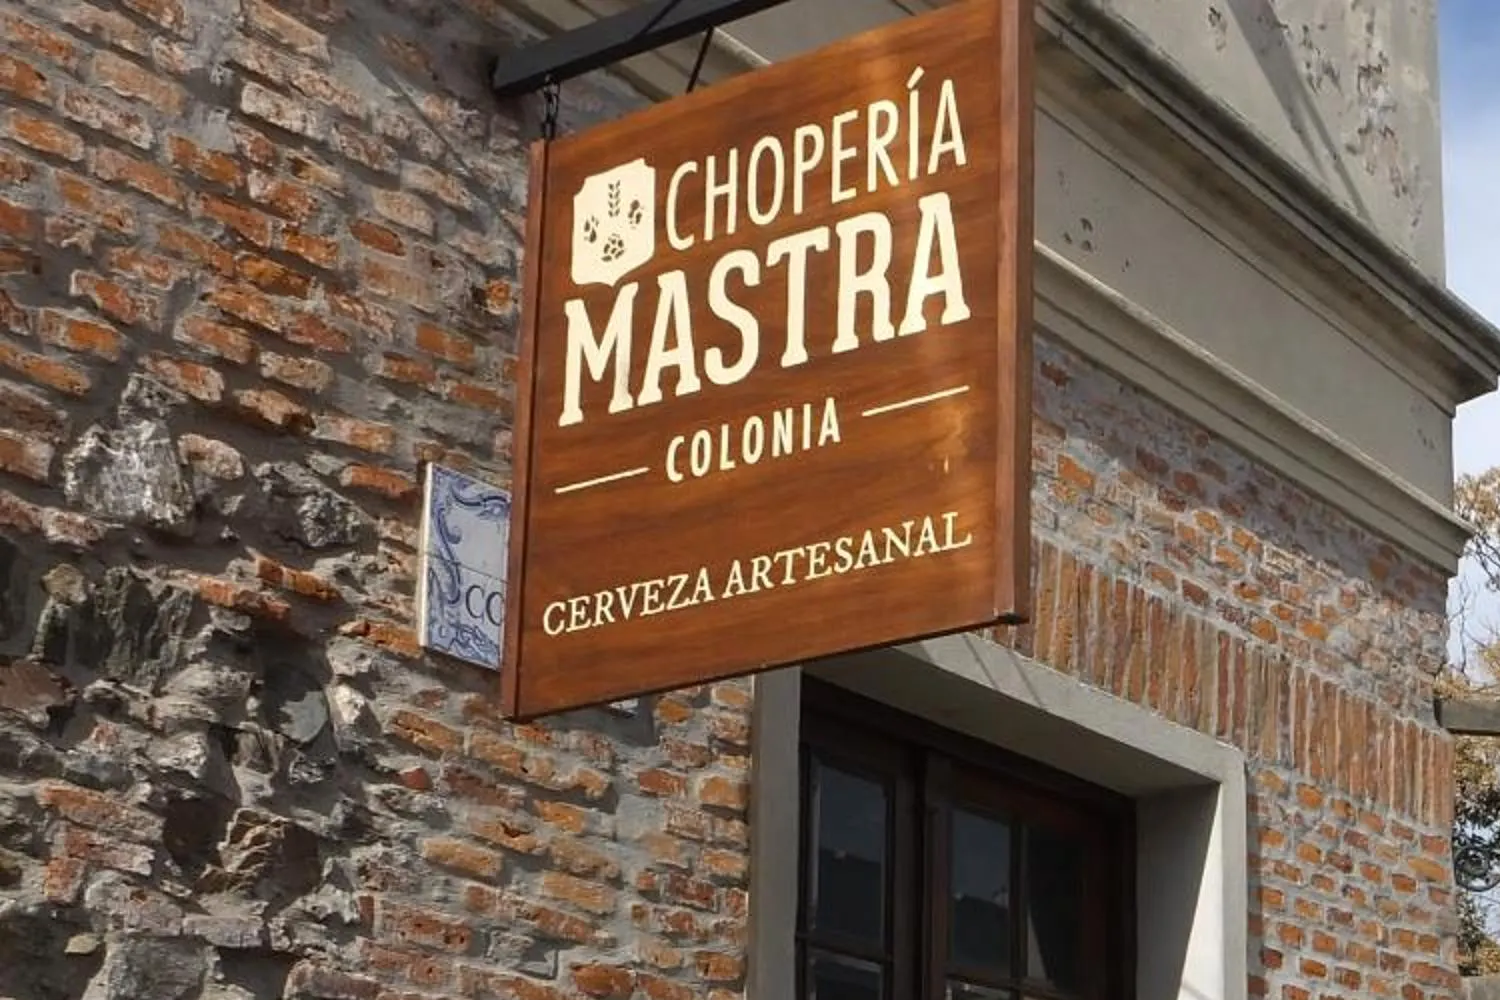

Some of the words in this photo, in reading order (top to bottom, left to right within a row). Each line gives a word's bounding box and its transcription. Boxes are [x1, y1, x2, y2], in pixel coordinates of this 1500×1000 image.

[666, 66, 967, 251] CHOPERÍA
[558, 191, 971, 427] MASTRA
[666, 397, 841, 482] COLONIA
[543, 567, 715, 635] CERVEZA
[722, 511, 973, 600] ARTESANAL
